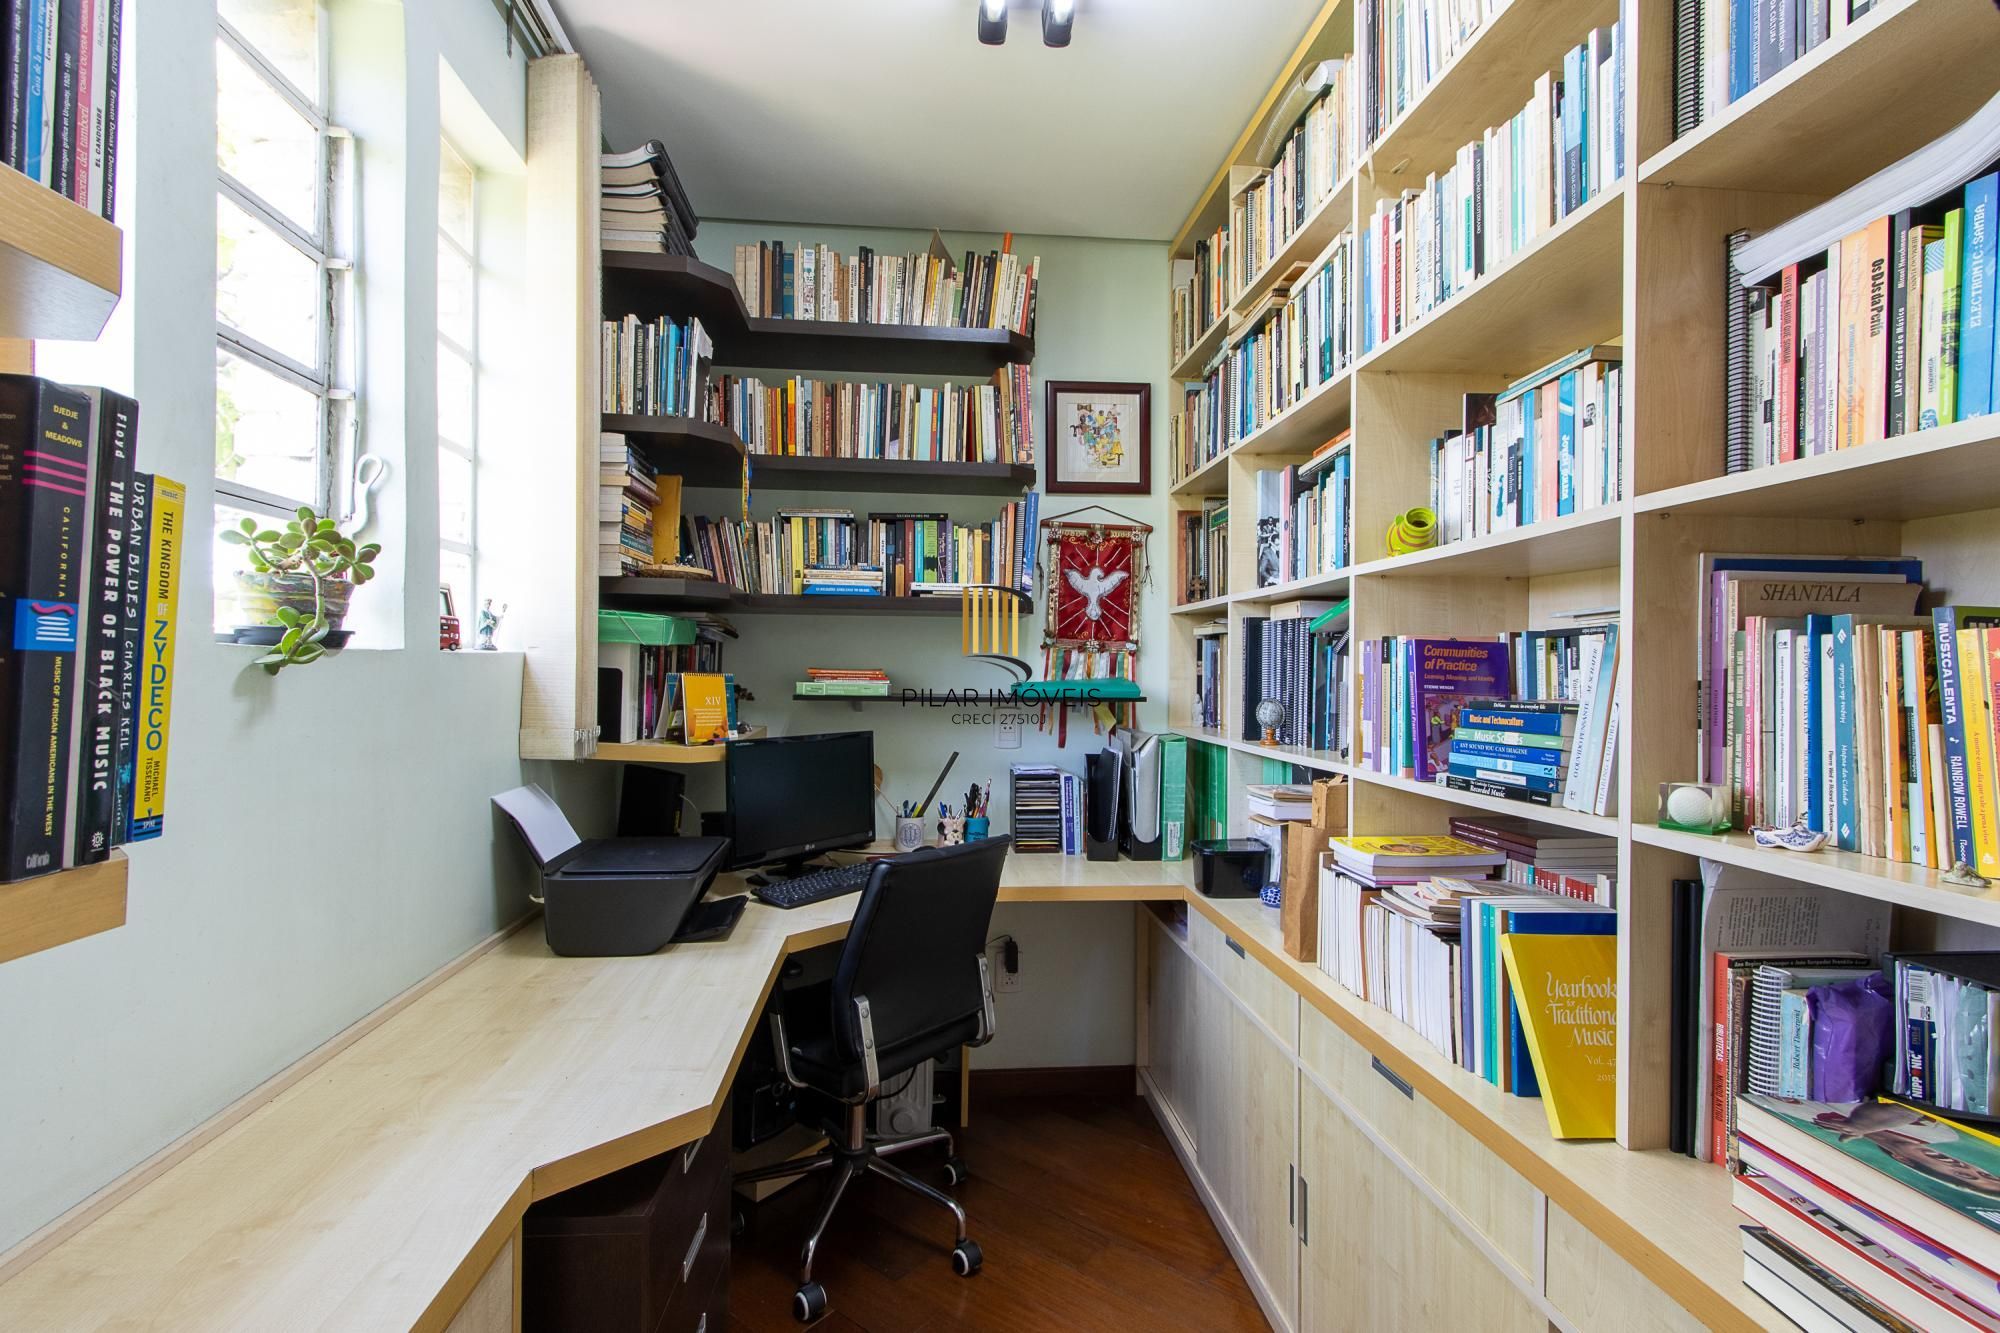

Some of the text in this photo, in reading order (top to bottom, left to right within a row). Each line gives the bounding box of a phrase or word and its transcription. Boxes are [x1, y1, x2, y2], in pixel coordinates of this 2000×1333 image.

[1784, 274, 1793, 293] VIVER
[1783, 299, 1793, 324] MELHOR
[1783, 325, 1792, 338] QUE
[1895, 378, 1903, 397] LAPA
[53, 405, 79, 420] DJEDJE
[61, 421, 69, 430] &
[45, 430, 83, 448] MEADOWS
[162, 511, 174, 535] THE
[58, 506, 71, 598] CALIFORNIA
[158, 540, 172, 599] KINGDOM
[93, 413, 128, 791] Floyd THE POWER OF BLACK MUSIC
[1760, 583, 1861, 603] SHANTALA
[119, 481, 146, 750] URBAN BLUES CHARLES KEIL
[1424, 644, 1489, 659] Communities
[1937, 622, 1953, 678] MÚSICA
[53, 656, 62, 683] MUSIC
[1424, 659, 1478, 672] of Practice
[53, 683, 61, 696] OF
[145, 620, 169, 751] ZYDECO
[705, 696, 721, 705] XIV
[1943, 679, 1957, 725] LENTA
[50, 697, 60, 733] AFRICAN
[1469, 714, 1524, 727] Music and Technoculture
[1745, 713, 1753, 734] DANÇA
[1474, 730, 1495, 742] Music
[1973, 737, 1981, 755] morte
[48, 734, 58, 786] AMERICANS
[1506, 747, 1528, 755] IMAGINE
[143, 757, 153, 803] TISSERAND
[151, 760, 160, 797] MICHAEL
[1949, 756, 1965, 795] RAINBOW
[1976, 773, 1985, 781] dia
[1470, 785, 1506, 798] Recorded Music
[1975, 782, 1985, 793] que
[46, 792, 55, 812] THE
[1978, 794, 1987, 806] vale
[1953, 796, 1969, 829] ROWELL
[44, 813, 54, 836] WEST
[1546, 971, 1617, 1000] Yearbook
[1545, 999, 1617, 1025] Traditiona
[1567, 1027, 1615, 1046] Music
[1715, 1022, 1724, 1062] BIBLIOTECAS
[1715, 1074, 1724, 1096] MUNDO
[1715, 1096, 1724, 1122] ANTIGO
